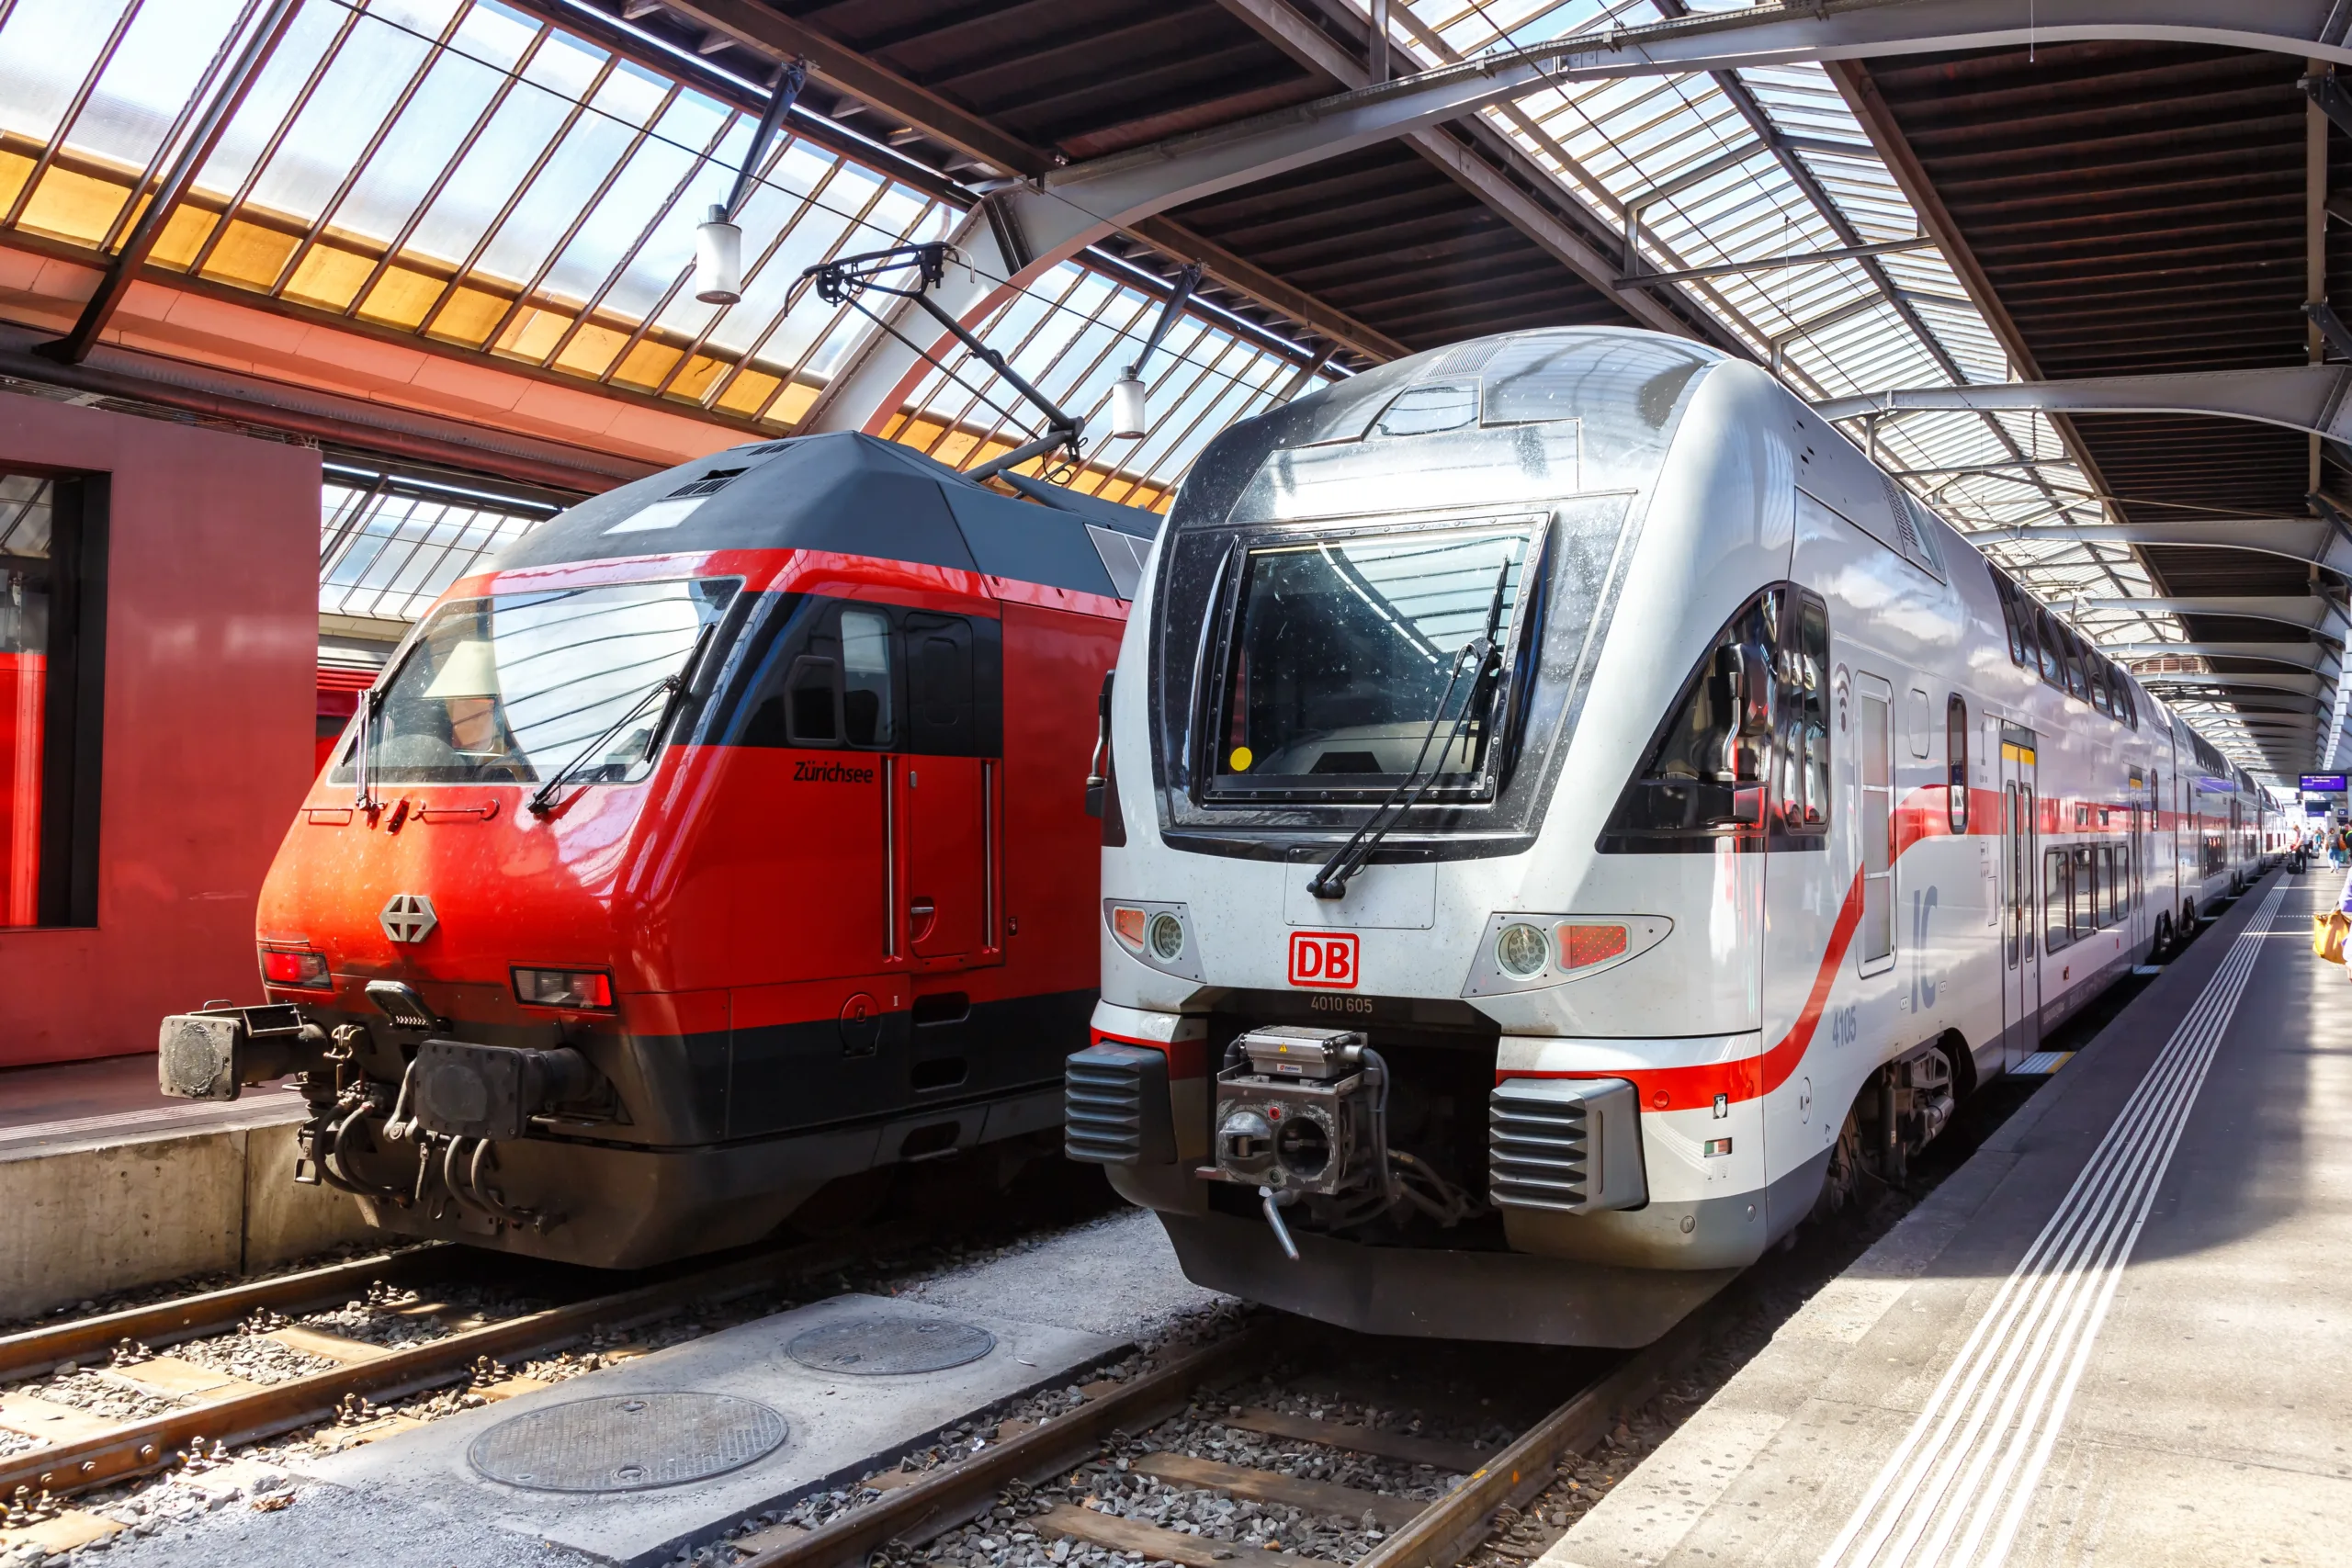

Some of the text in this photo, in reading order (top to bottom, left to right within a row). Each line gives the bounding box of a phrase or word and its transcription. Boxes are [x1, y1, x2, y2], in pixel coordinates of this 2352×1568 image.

[793, 760, 874, 784] Zürichsee
[1297, 941, 1351, 979] DB
[1911, 885, 1938, 1014] IC
[1311, 996, 1373, 1013] 4010 605
[1832, 1005, 1857, 1048] 4105
